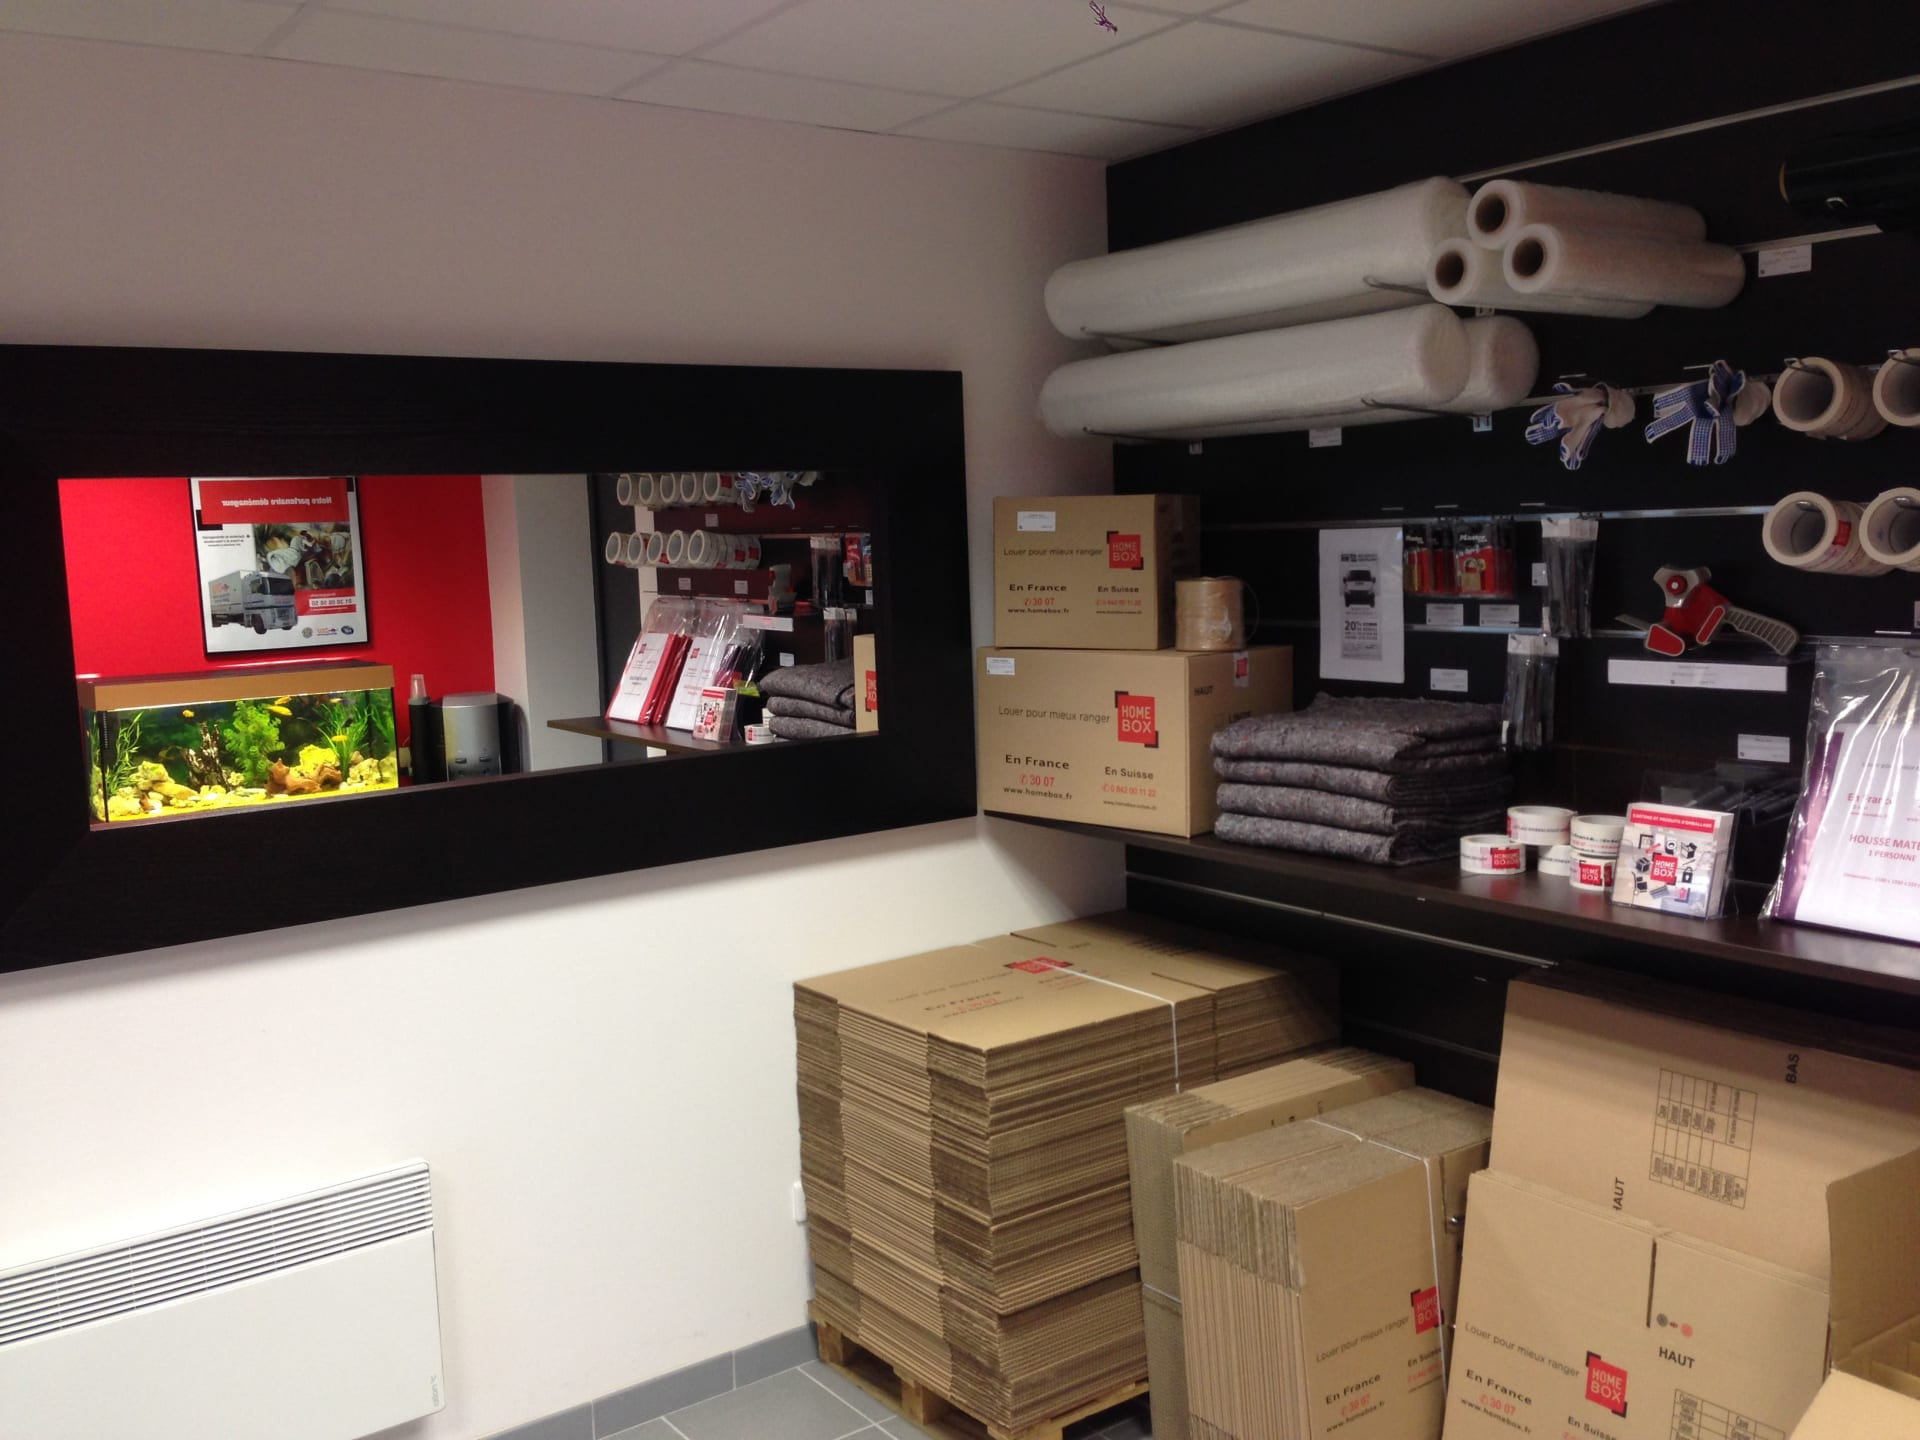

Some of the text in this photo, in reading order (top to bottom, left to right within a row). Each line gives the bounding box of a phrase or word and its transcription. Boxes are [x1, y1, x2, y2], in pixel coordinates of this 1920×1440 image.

[1003, 548, 1026, 556] Louer
[1028, 549, 1048, 558] pour
[1050, 548, 1074, 556] mieux
[1113, 542, 1138, 551] HOME
[1113, 552, 1138, 562] BOX
[1009, 584, 1067, 592] En France
[999, 706, 1110, 724] Louer pour mieux ranger
[1122, 705, 1152, 720] HOME
[1122, 719, 1152, 733] BOX
[1005, 754, 1070, 770] En France
[1030, 774, 1055, 787] 30 07
[1105, 766, 1154, 780] En Suisse
[1003, 786, 1073, 801] www.homebox.fr
[1849, 834, 1891, 847] HOUSSE
[1874, 850, 1917, 862] PERSONNE
[1655, 860, 1675, 868] HOME
[1654, 868, 1673, 877] BOX
[1785, 1053, 1800, 1083] BAS
[1315, 1347, 1338, 1363] Louer
[1465, 1322, 1580, 1377] Louer pour mieux ranger
[1659, 1346, 1695, 1369] HAUT
[1591, 1367, 1623, 1390] HOME
[1325, 1374, 1381, 1405] En France
[1466, 1368, 1482, 1384] En
[1486, 1378, 1532, 1405] France
[1590, 1380, 1621, 1405] BOX
[1490, 1396, 1516, 1415] 30 07
[1461, 1398, 1532, 1435] www.homebox.fr
[1568, 1416, 1580, 1428] En
